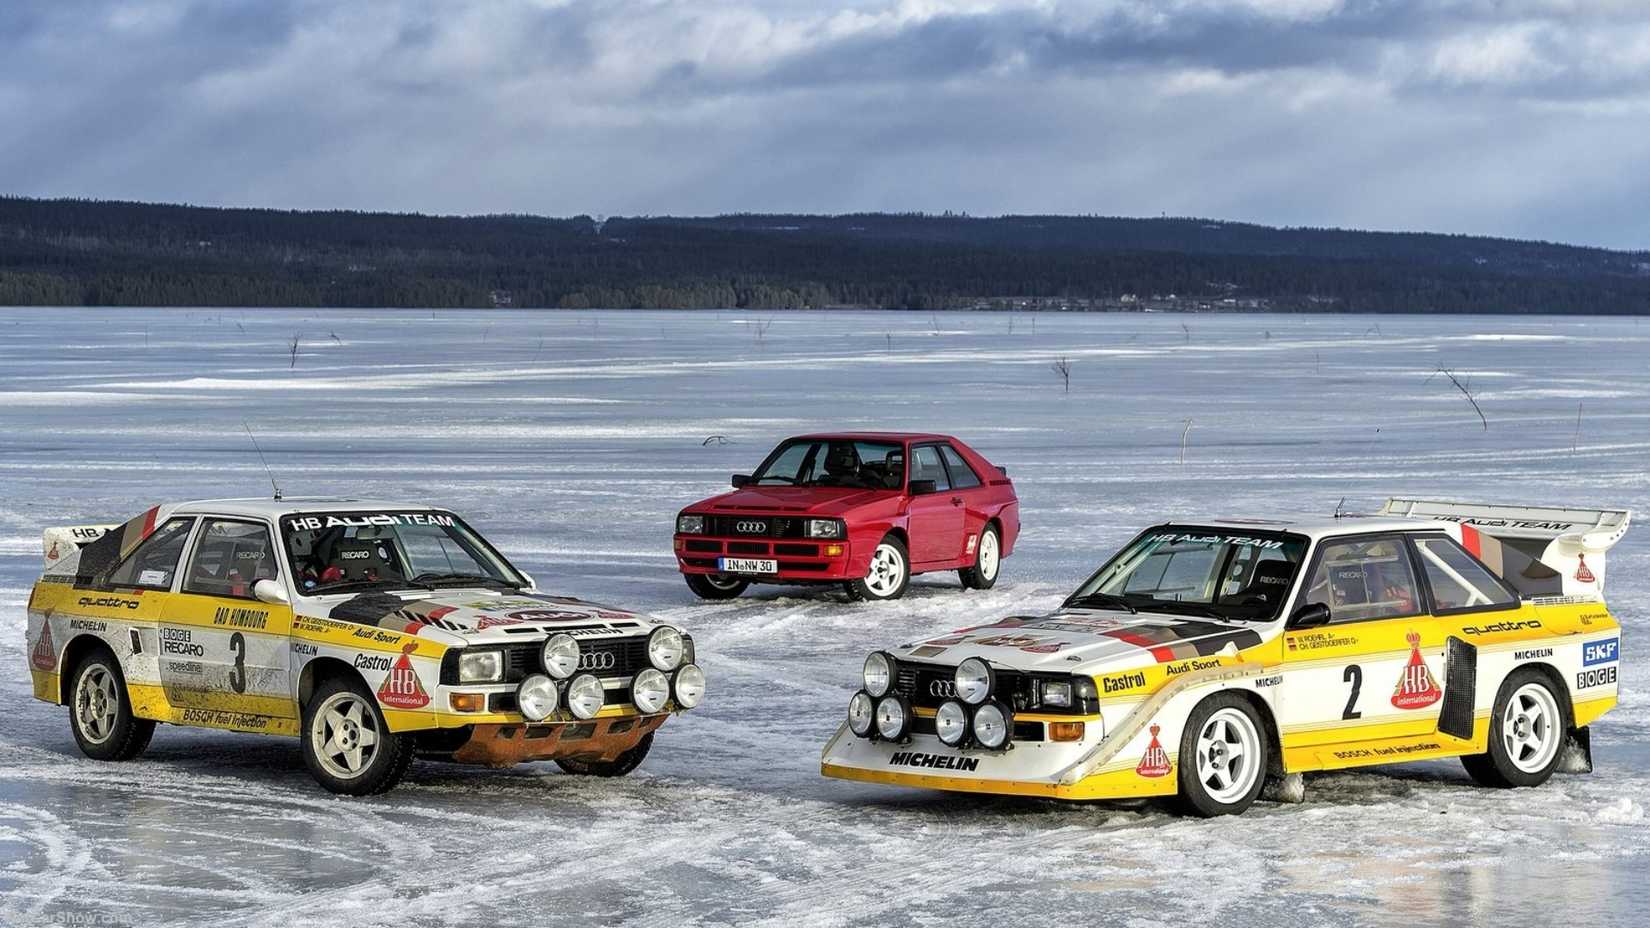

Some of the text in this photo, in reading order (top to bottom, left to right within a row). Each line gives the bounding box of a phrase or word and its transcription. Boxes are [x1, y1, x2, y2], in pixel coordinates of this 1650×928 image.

[291, 517, 322, 531] HB
[401, 514, 455, 527] TEAM
[1510, 520, 1573, 531] TEAM
[72, 528, 101, 538] HB
[1224, 535, 1284, 550] TEAM
[341, 551, 370, 560] RECARO
[727, 559, 773, 572] IN NW 30
[78, 597, 140, 610] quattro
[70, 618, 108, 632] MICHELIN
[1462, 619, 1542, 636] quattro
[163, 627, 192, 642] BOGE
[352, 628, 404, 645] Audi Sport
[164, 641, 205, 657] RECARO
[1514, 648, 1554, 661] MICHELIN
[1585, 645, 1617, 662] SKF
[229, 631, 246, 693] 3
[353, 652, 393, 672] Castrol
[1165, 658, 1222, 676] Audi Sport
[389, 668, 417, 695] HB
[1102, 671, 1146, 693] Castrol
[1403, 664, 1430, 695] HB
[1577, 666, 1617, 690] BOGE
[1341, 663, 1363, 721] 2
[183, 709, 214, 723] BOSCH
[214, 711, 234, 724] fuel
[889, 751, 980, 772] MICHELIN
[1334, 750, 1374, 759] BOSCH
